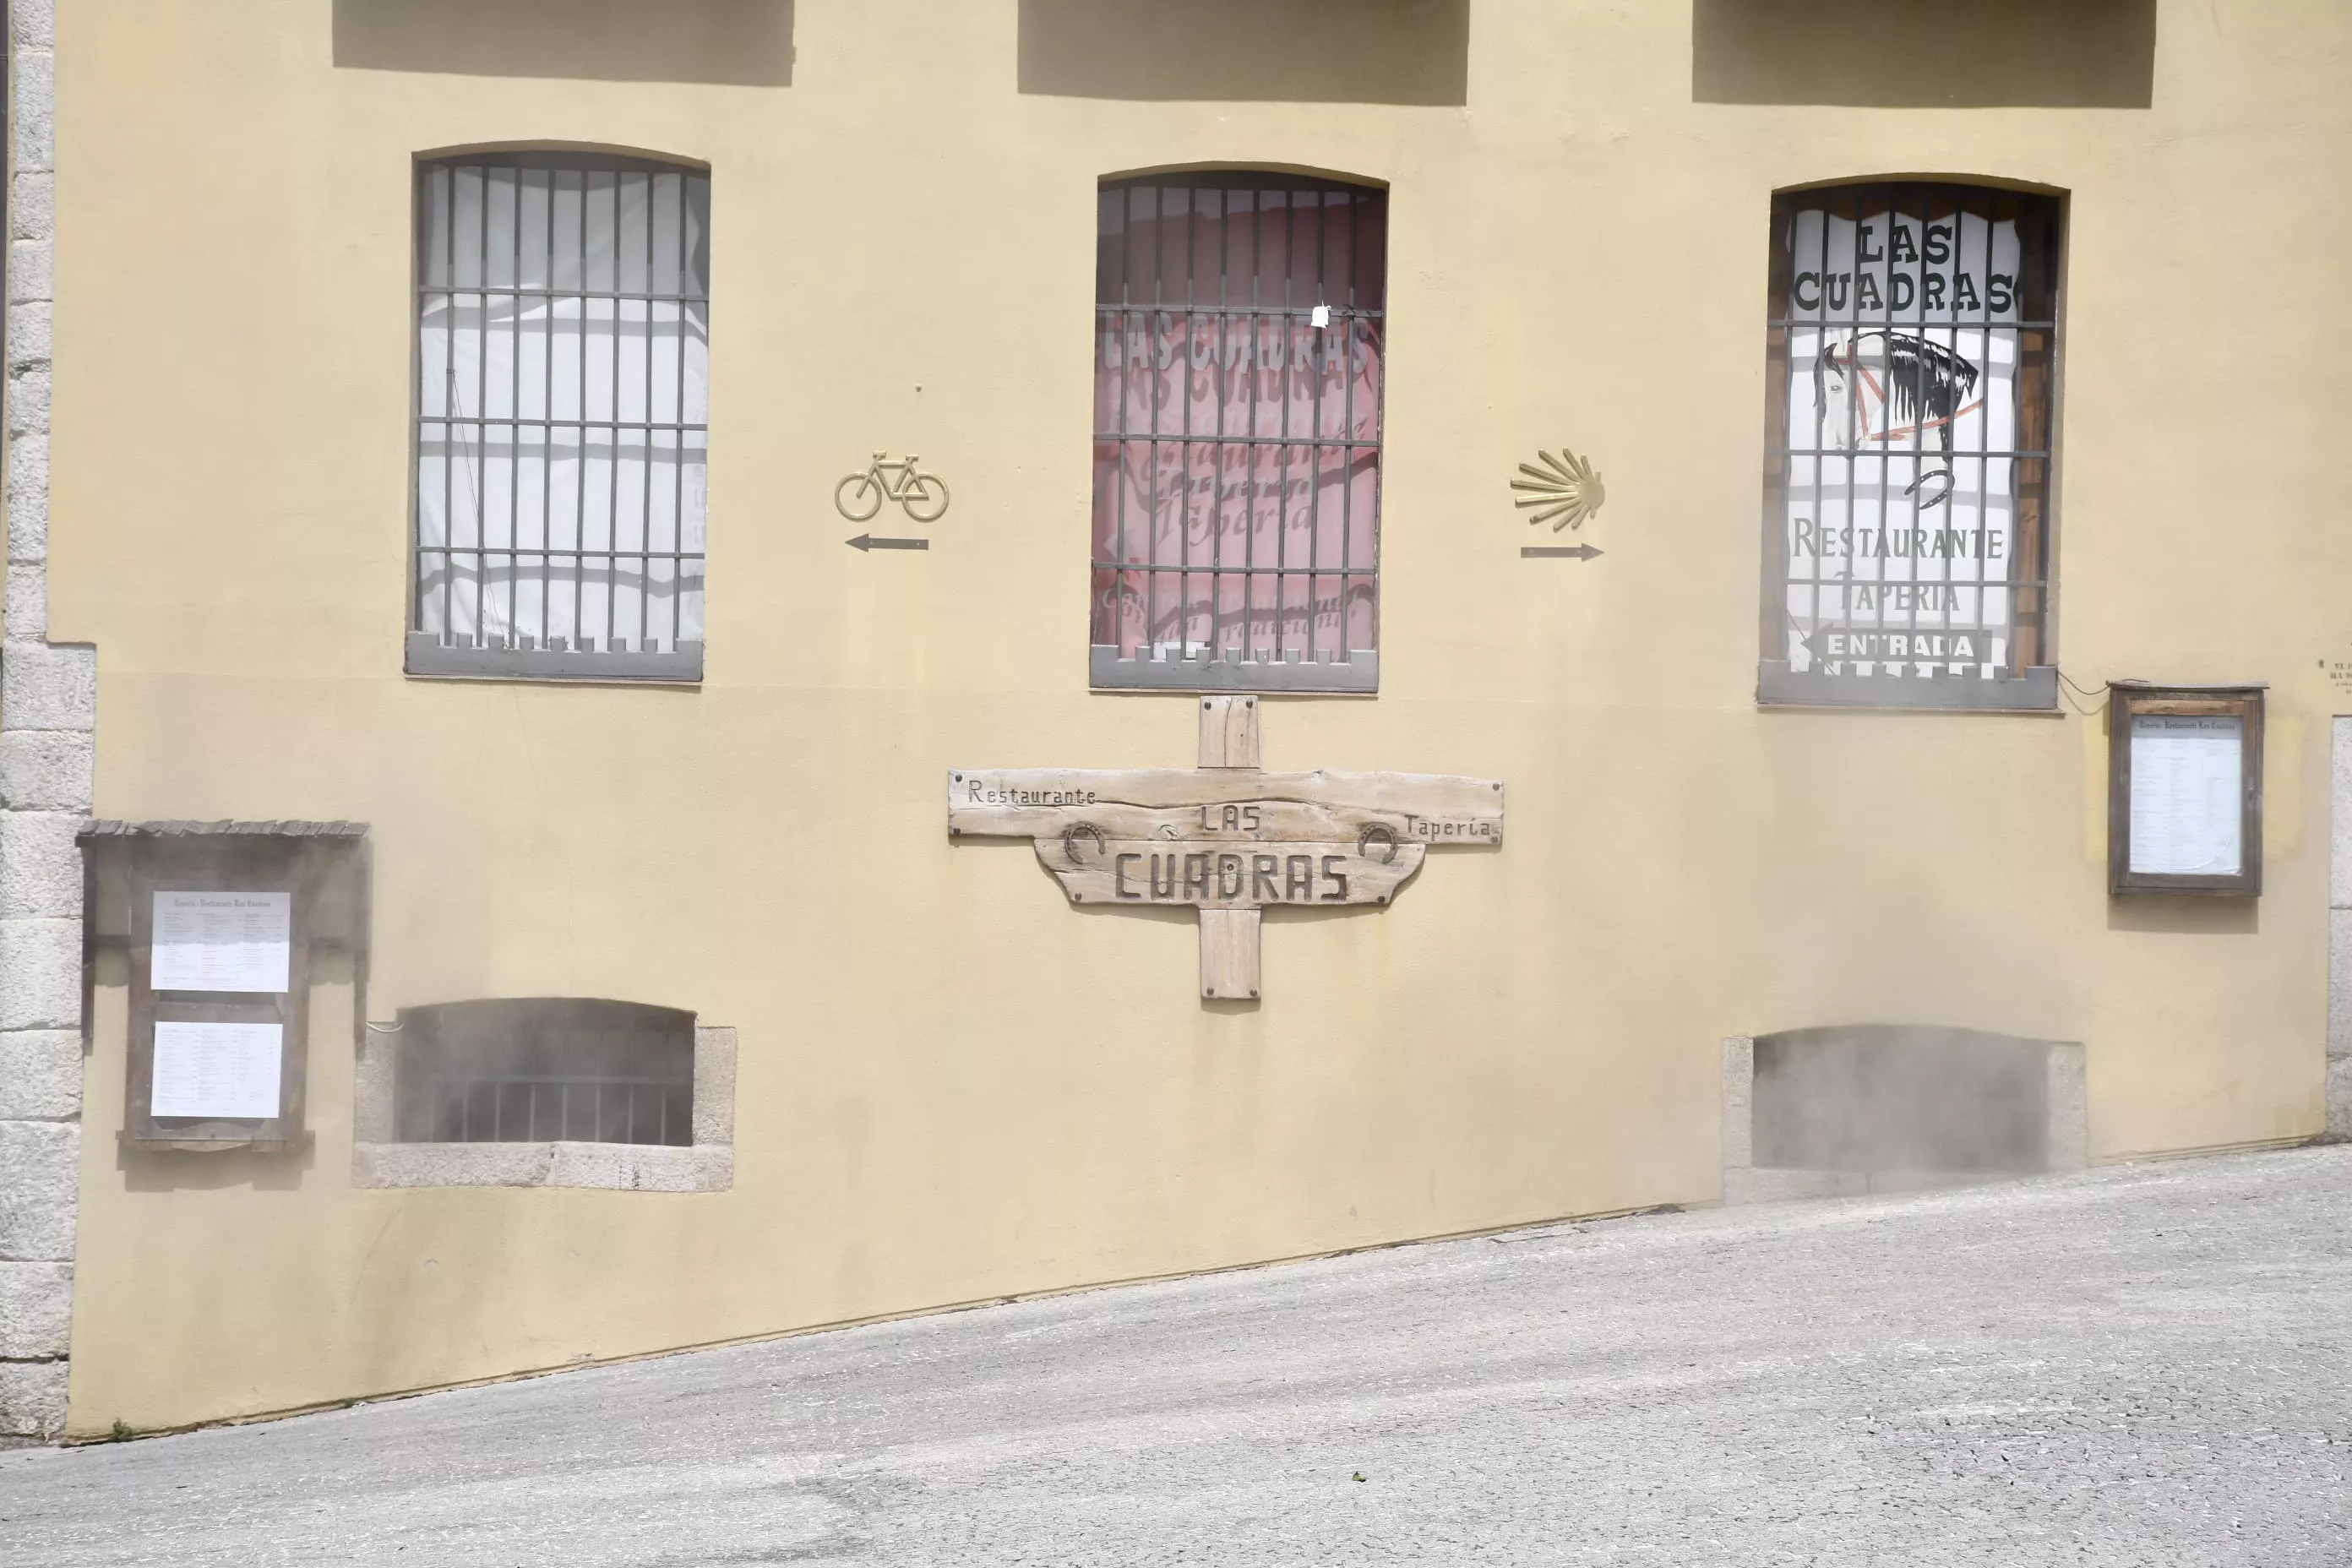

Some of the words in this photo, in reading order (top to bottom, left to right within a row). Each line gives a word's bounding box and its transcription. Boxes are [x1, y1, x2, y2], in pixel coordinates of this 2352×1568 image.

[1858, 225, 1953, 264] LAS
[1794, 271, 2013, 313] CUADRAS
[1827, 634, 1975, 657] ENTRADA
[968, 779, 1097, 803] Restaurante
[1200, 804, 1261, 831] LAS
[1114, 852, 1348, 902] CUADRAS
